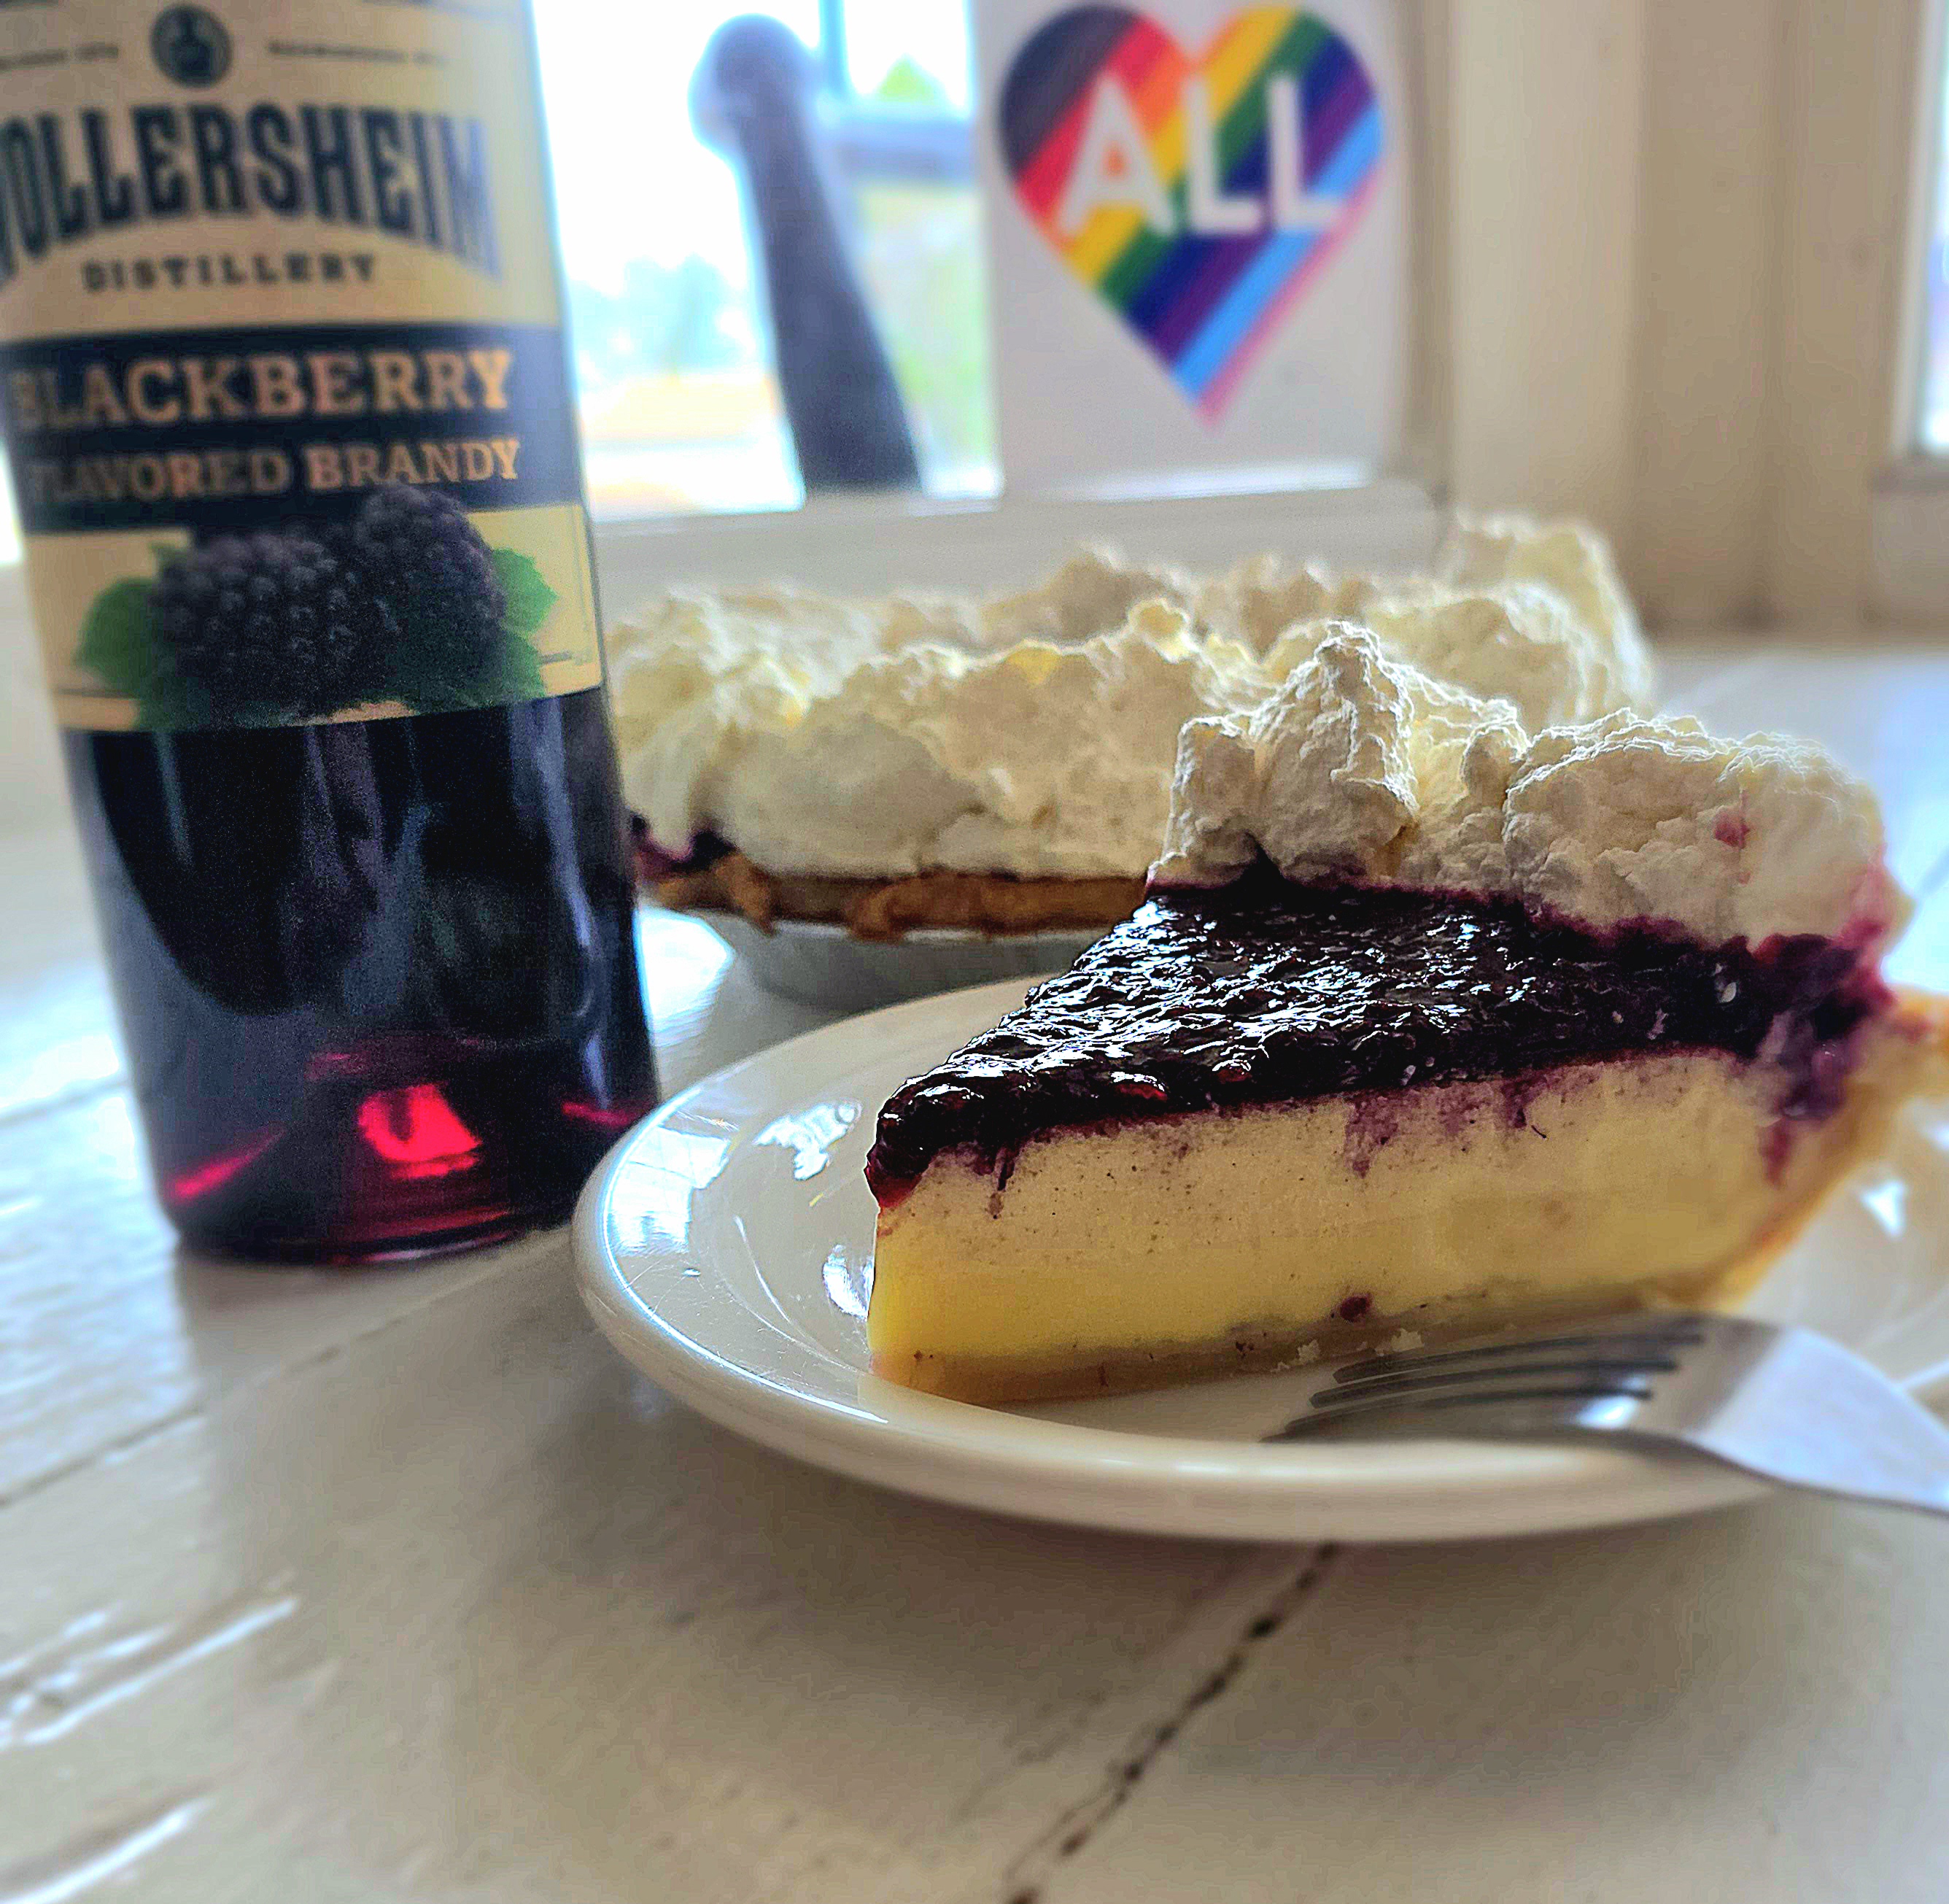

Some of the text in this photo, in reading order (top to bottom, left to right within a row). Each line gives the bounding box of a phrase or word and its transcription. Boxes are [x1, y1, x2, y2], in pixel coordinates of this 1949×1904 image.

[0, 103, 500, 282] OLLERSHEIM
[1055, 71, 1341, 236] ALL
[82, 252, 376, 292] DISTILLERY
[12, 350, 510, 430] BLACKBERRY
[302, 438, 521, 492] BRANDY
